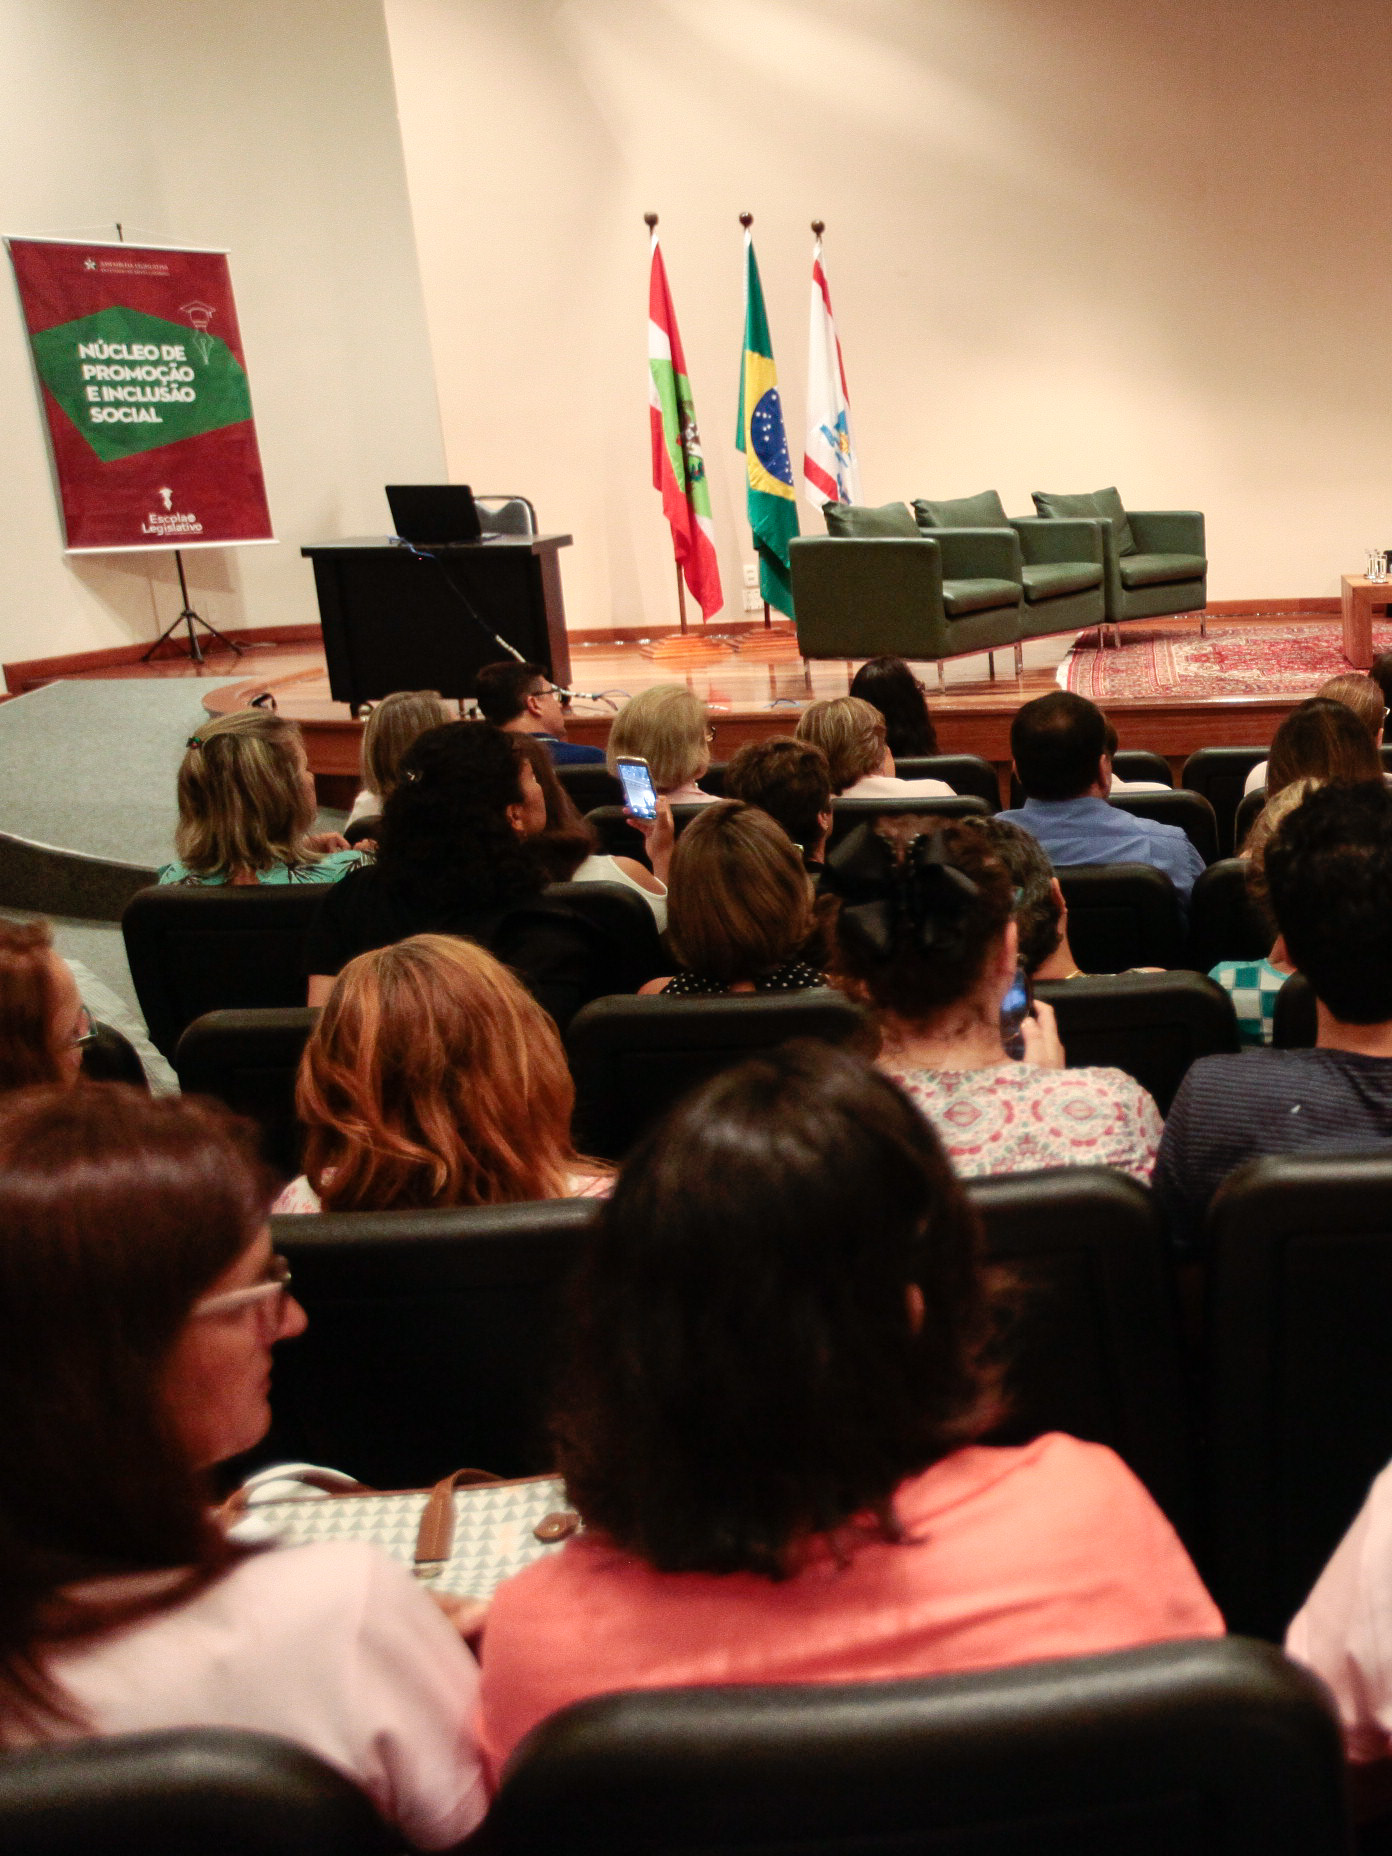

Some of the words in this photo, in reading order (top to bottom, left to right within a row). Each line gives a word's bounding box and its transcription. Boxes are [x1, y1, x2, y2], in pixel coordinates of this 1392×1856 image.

[78, 338, 160, 360] NÚCLEO
[161, 344, 187, 361] DE
[82, 362, 195, 386] PROMOÇÃO
[86, 385, 101, 402] E
[102, 383, 196, 403] INCLUSÃO
[90, 406, 163, 423] SOCIAL
[142, 523, 203, 536] Legislativo
